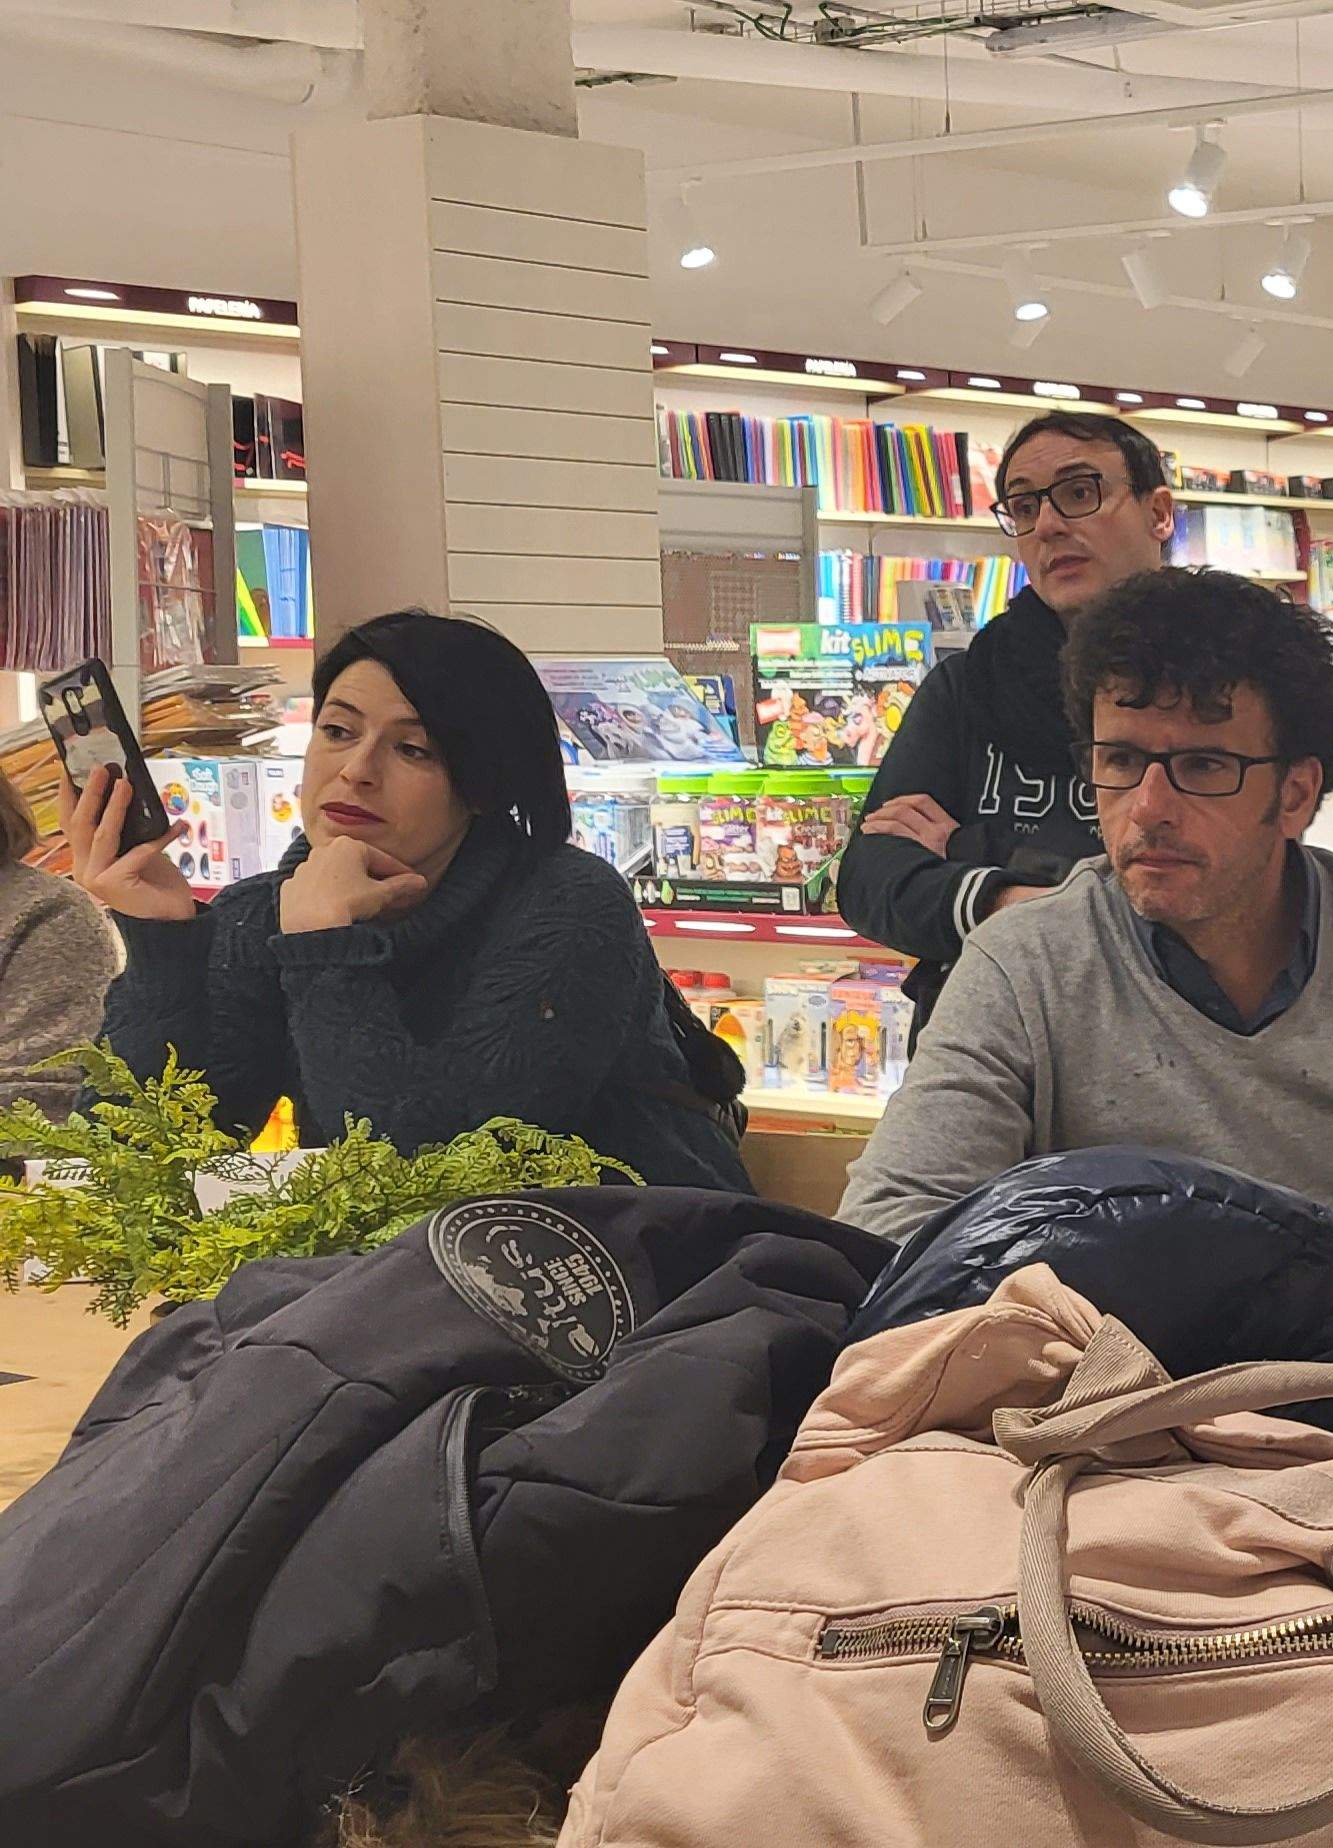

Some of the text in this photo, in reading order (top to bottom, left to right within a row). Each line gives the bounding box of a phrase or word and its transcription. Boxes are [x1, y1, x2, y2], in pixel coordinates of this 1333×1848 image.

[820, 628, 925, 665] kit SLIME
[544, 1256, 588, 1307] SINCE
[566, 1252, 605, 1297] 1945
